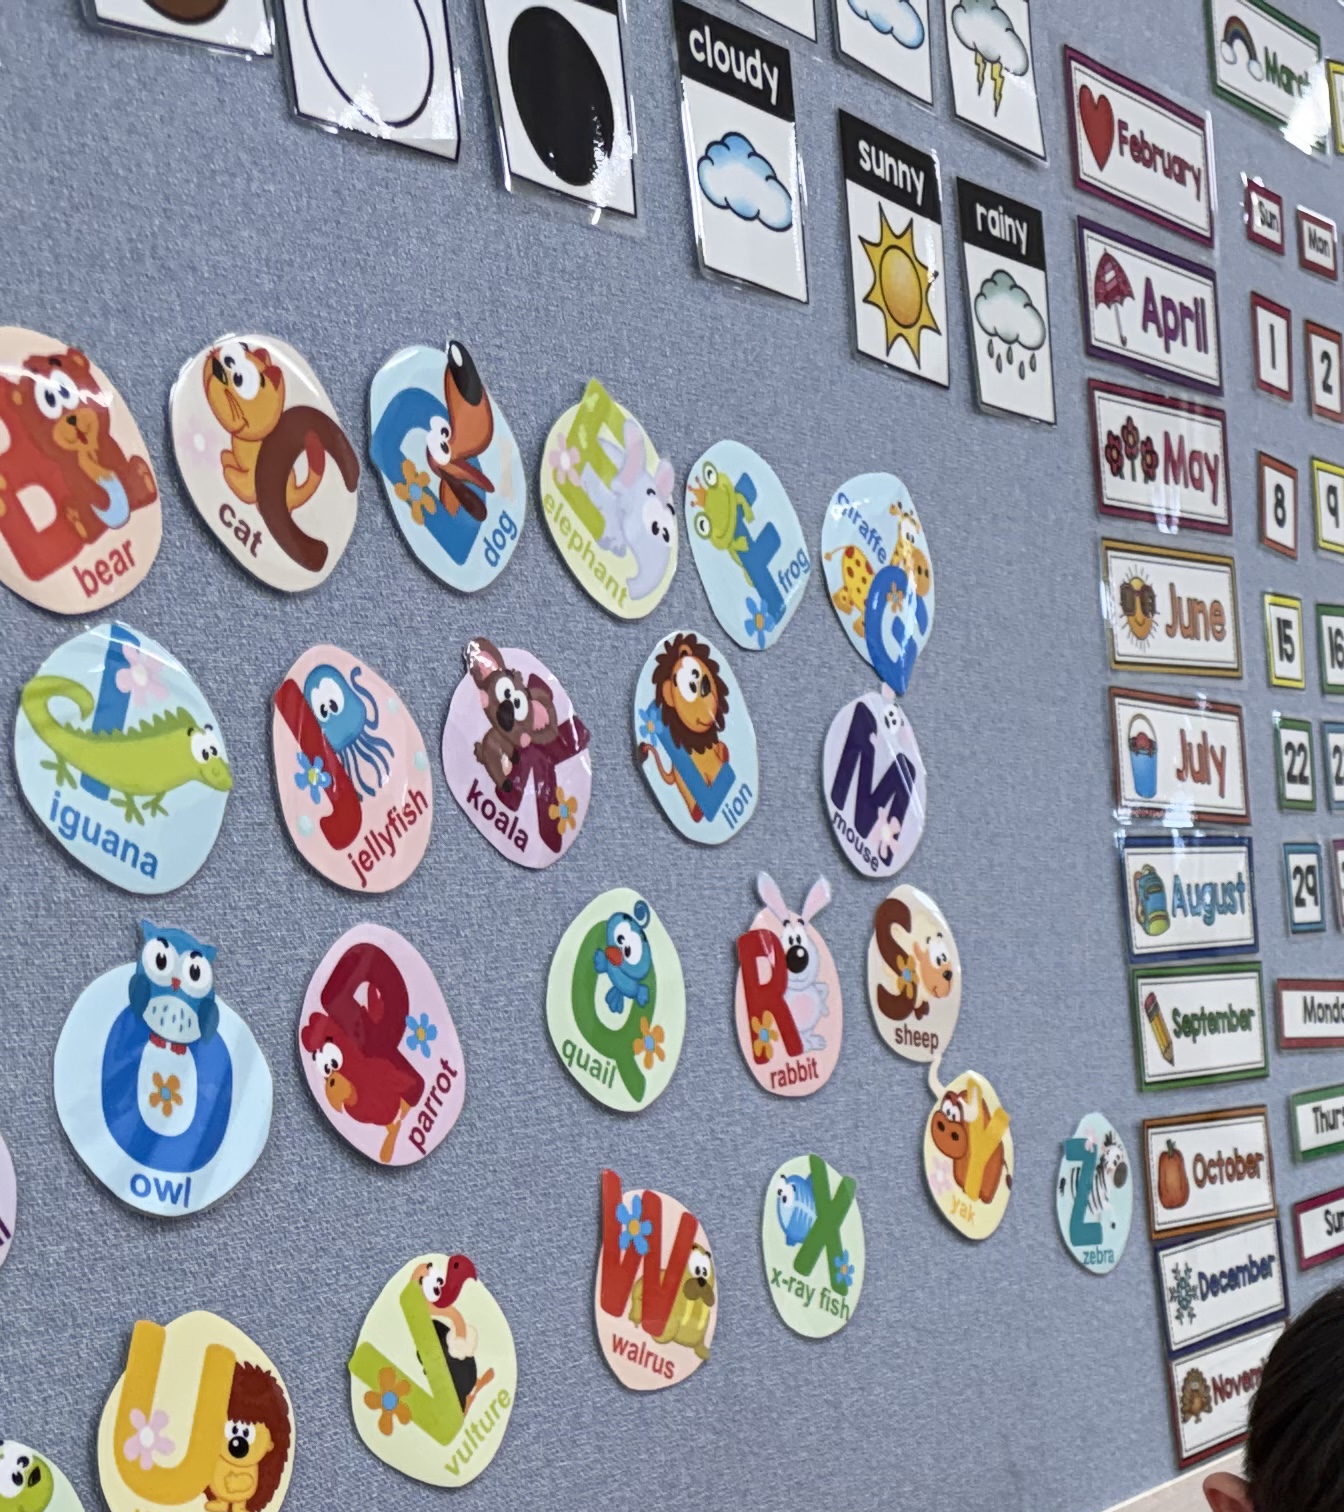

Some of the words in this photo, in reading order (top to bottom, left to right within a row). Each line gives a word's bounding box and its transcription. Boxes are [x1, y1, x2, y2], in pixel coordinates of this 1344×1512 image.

[688, 26, 779, 104] cloudy
[858, 137, 925, 193] sunny
[1118, 119, 1203, 190] February
[975, 201, 1029, 256] rainy
[1257, 200, 1280, 233] Sun
[1307, 229, 1331, 258] Mon
[1141, 277, 1210, 354] April
[1269, 323, 1277, 370] 1
[1320, 350, 1334, 395] 2
[1163, 430, 1220, 507] May
[217, 499, 266, 559] cat
[1273, 483, 1287, 528] 8
[1327, 484, 1340, 529] 9
[484, 508, 518, 567] dog
[543, 492, 630, 609] elephant
[72, 538, 136, 599] bear
[778, 546, 810, 594] frog
[1165, 582, 1227, 642] June
[1276, 617, 1296, 664] 15
[1175, 727, 1227, 799] July
[1284, 741, 1310, 786] 22
[467, 777, 531, 855] koala
[721, 784, 754, 829] lion
[49, 791, 160, 880] iguana
[347, 787, 430, 888] jellyfish
[832, 811, 880, 873] mouse
[1172, 872, 1246, 926] August
[1292, 864, 1319, 908] 29
[737, 928, 804, 1066] R
[1172, 1003, 1256, 1044] September
[561, 1037, 619, 1090] quail
[894, 1024, 940, 1053] sheep
[769, 1057, 820, 1091] rabbit
[407, 1057, 459, 1156] parrot
[130, 1173, 192, 1208] owl
[1193, 1146, 1264, 1189] October
[950, 1193, 976, 1227] yak
[1082, 1246, 1116, 1266] zebra
[1199, 1254, 1276, 1301] December
[770, 1266, 816, 1309] x-ray
[817, 1285, 851, 1321] fish
[610, 1333, 676, 1381] walrus
[114, 1320, 236, 1506] U
[442, 1387, 513, 1477] vulture
